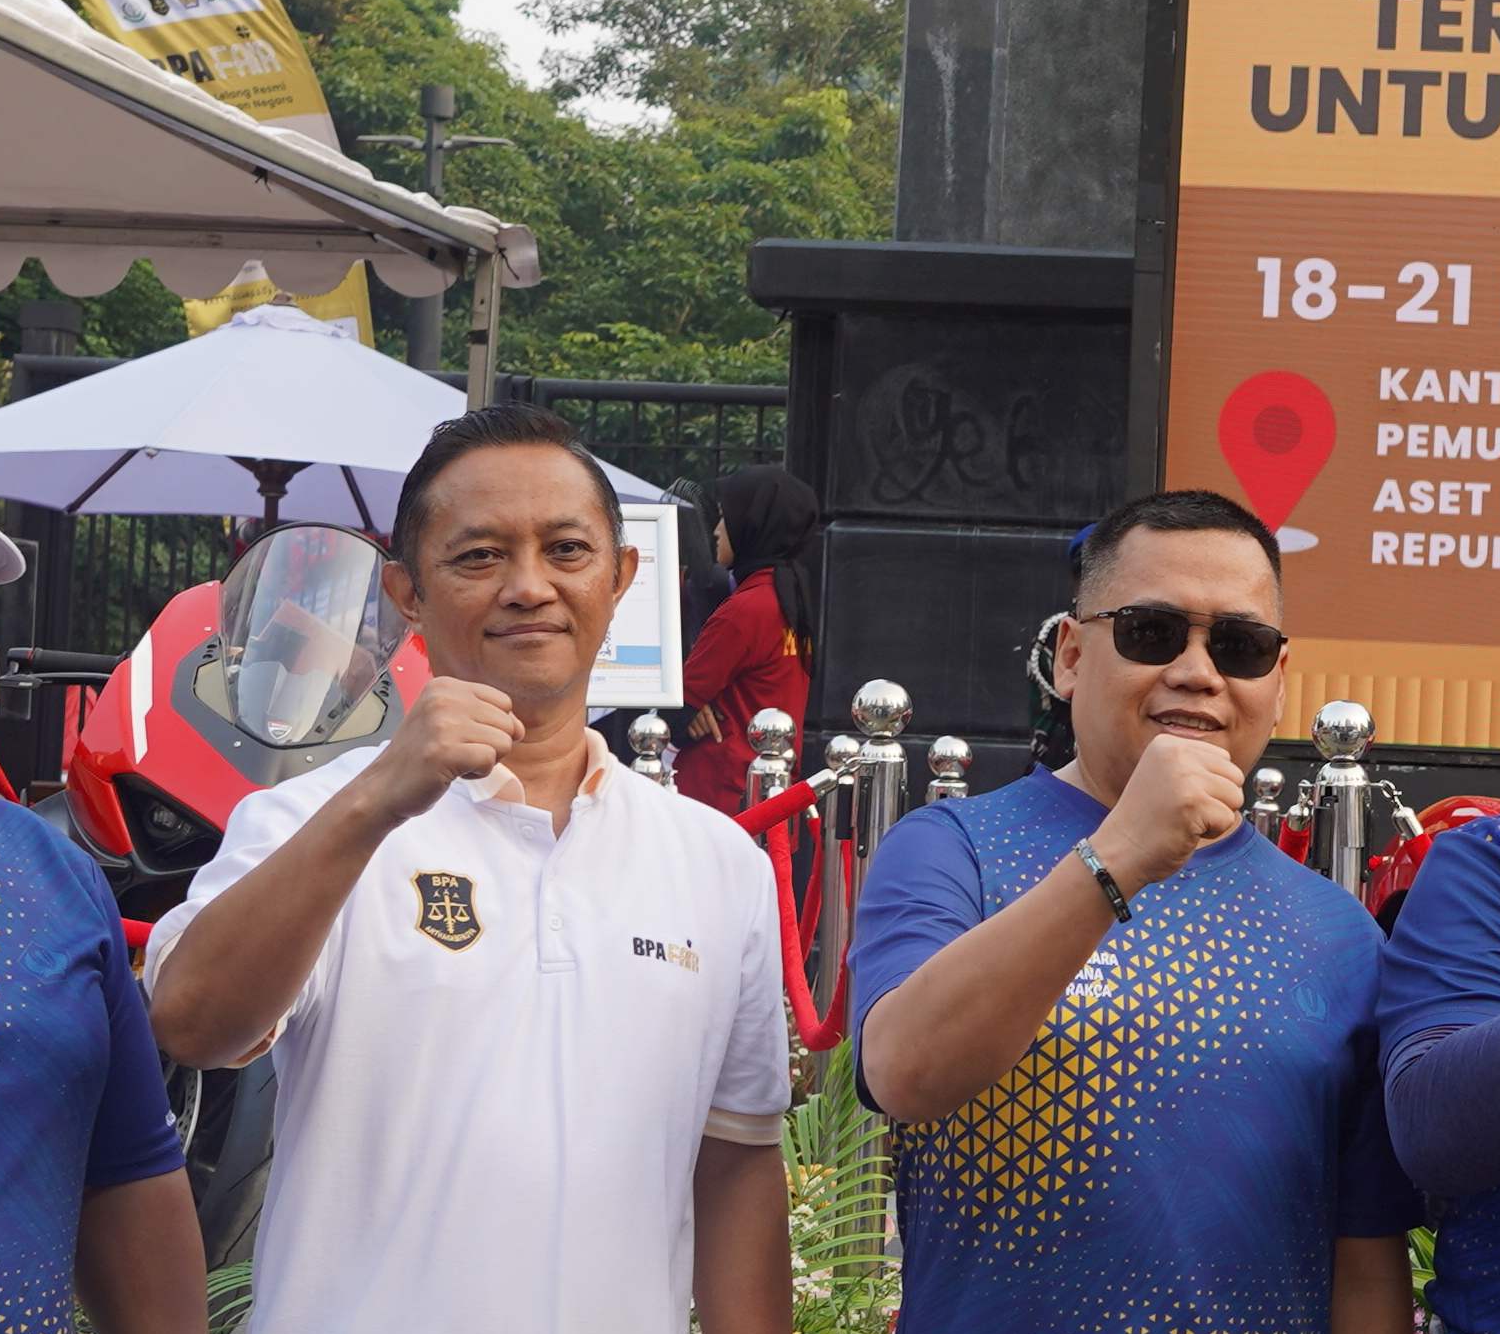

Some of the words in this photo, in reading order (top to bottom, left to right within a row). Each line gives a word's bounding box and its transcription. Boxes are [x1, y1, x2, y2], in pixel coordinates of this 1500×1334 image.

[1257, 256, 1472, 326] 18-21
[1372, 479, 1491, 516] ASET
[431, 875, 459, 887] BPA
[632, 936, 667, 962] BPA
